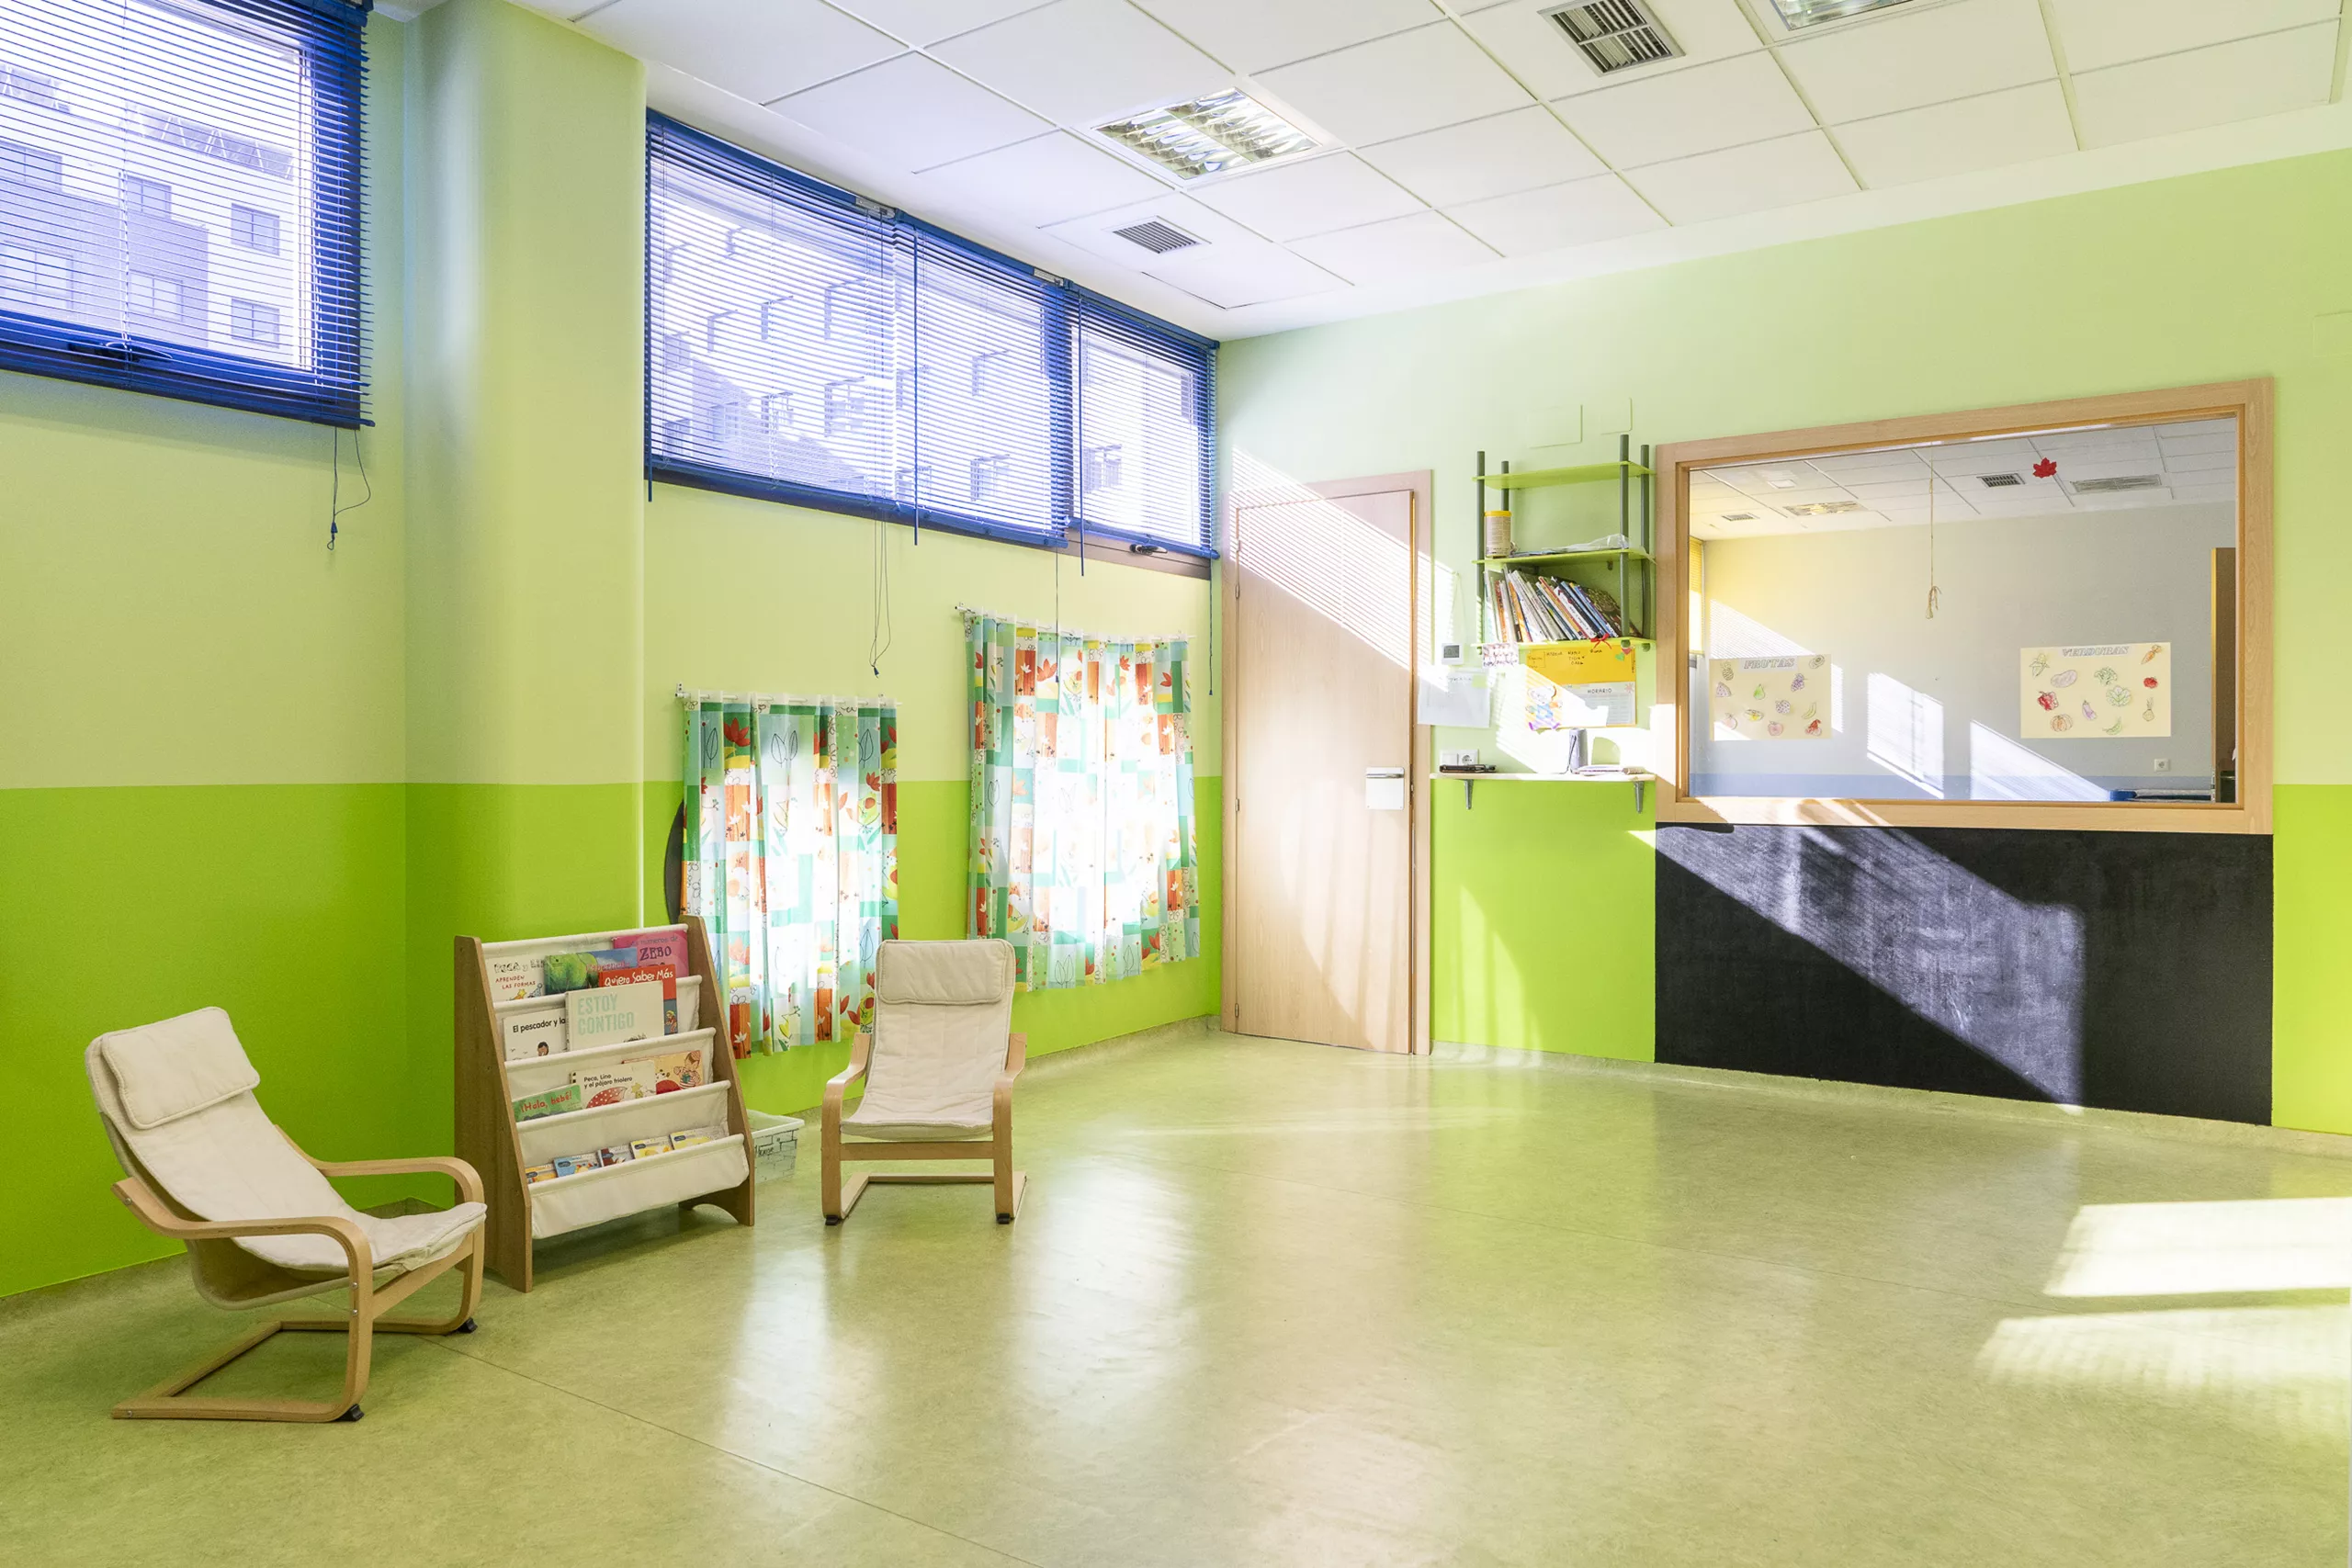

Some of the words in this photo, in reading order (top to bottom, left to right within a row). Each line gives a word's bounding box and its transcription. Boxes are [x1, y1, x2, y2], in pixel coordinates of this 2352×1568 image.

[2062, 646, 2130, 657] VERDURAS
[1743, 658, 1795, 670] FRUTAS
[495, 975, 526, 983] APRENDEN
[604, 976, 630, 987] Quiero
[631, 971, 654, 984] Saber
[656, 967, 673, 980] Más
[514, 980, 536, 988] FORMAS
[577, 993, 618, 1016] ESTOY
[513, 1024, 519, 1033] El
[520, 1020, 552, 1033] pescador
[577, 1011, 635, 1036] CONTIGO
[613, 1076, 633, 1084] friolero
[520, 1099, 548, 1113] ¡Hola,
[550, 1089, 572, 1105] bebé!
